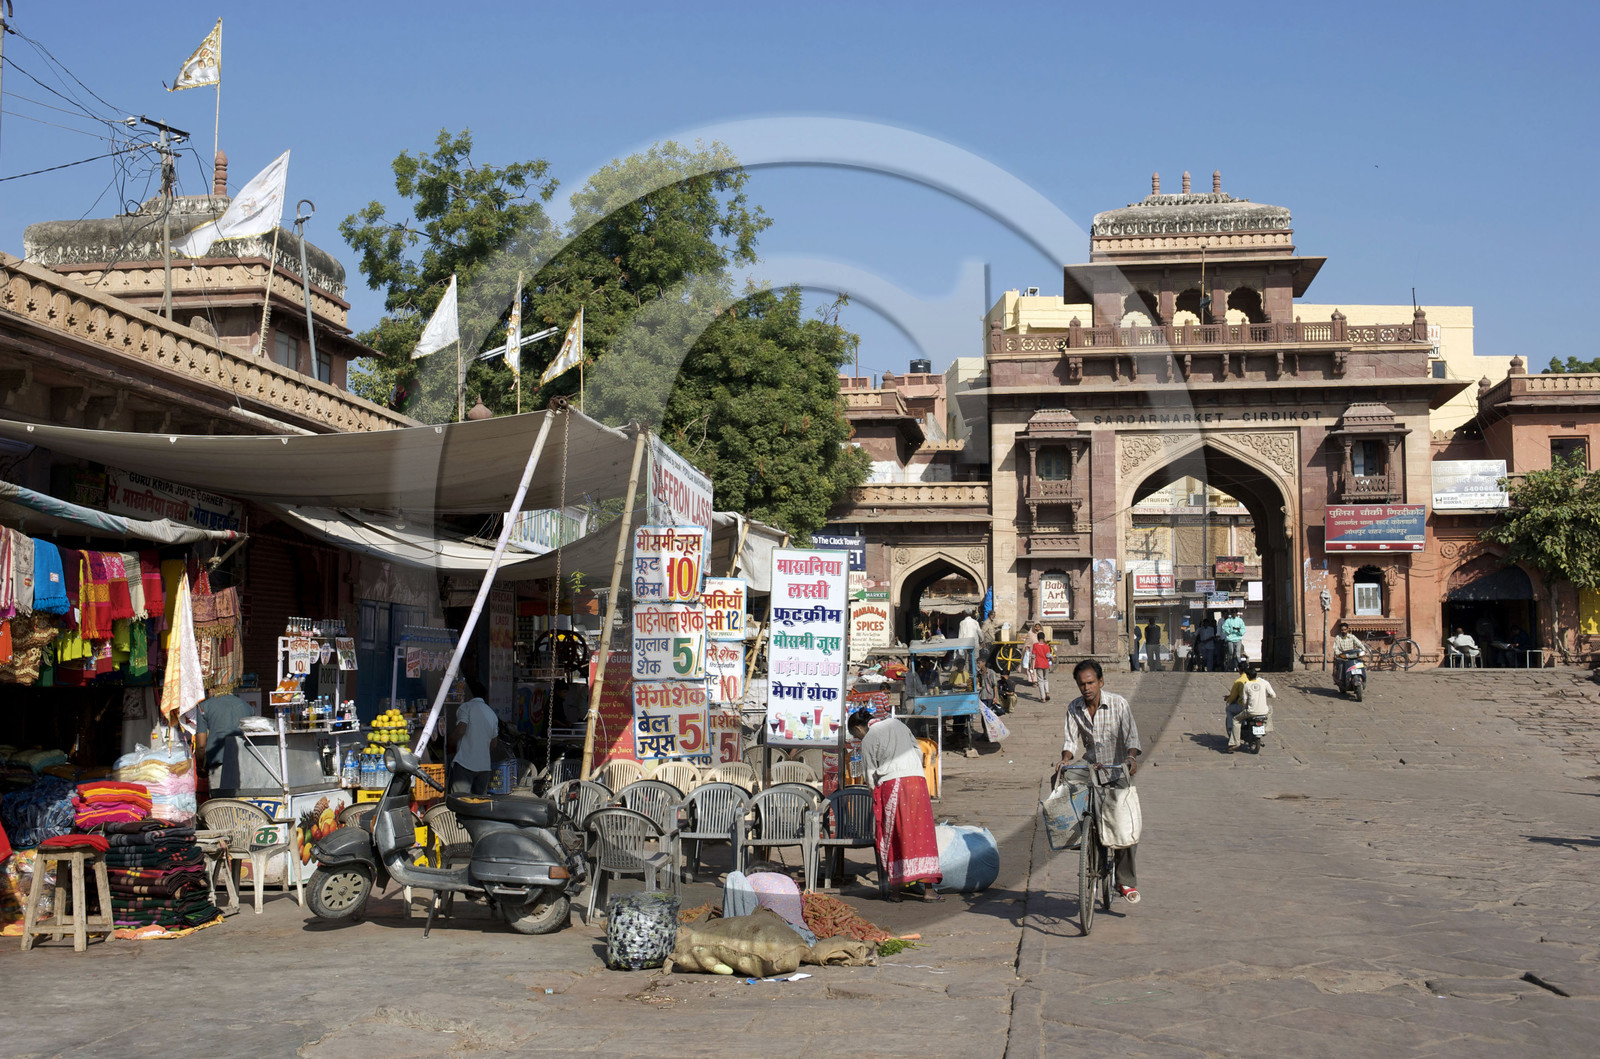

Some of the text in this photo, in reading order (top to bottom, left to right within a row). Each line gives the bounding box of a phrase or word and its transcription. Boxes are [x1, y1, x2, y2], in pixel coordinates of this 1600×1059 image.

[1093, 411, 1321, 425] SARDARMARKET GIRDIKOT
[152, 478, 174, 494] KRIPA
[175, 484, 196, 499] JUICE
[197, 489, 224, 507] CORNER
[652, 459, 690, 519] SAFFRON
[692, 491, 712, 532] LASSI
[1328, 508, 1354, 518] पुलिस
[1360, 507, 1383, 516] चौकी
[637, 528, 703, 556] मौसमी जूस
[818, 537, 829, 545] The
[829, 537, 844, 545] Clock
[844, 538, 861, 546] Tower
[777, 556, 843, 576] माखनिया
[1045, 581, 1067, 590] Baba
[1139, 576, 1171, 584] MANSION
[788, 580, 831, 600] लस्सी
[1048, 591, 1064, 599] Art
[635, 606, 704, 635] पाईनेपल शेक
[853, 606, 887, 620] MAHARAJA
[856, 621, 884, 631] SPICES
[635, 638, 671, 657] गुलाब
[773, 630, 842, 656] मौसमी जूस
[611, 655, 632, 663] GURU
[719, 646, 740, 662] शेक
[636, 656, 662, 675] शेक
[635, 684, 671, 708] मैंगो
[672, 684, 706, 706] शेक
[807, 683, 839, 701] शेक
[637, 710, 671, 733] बेल
[618, 746, 633, 754] Juice
[637, 734, 676, 758] ज्यूस
